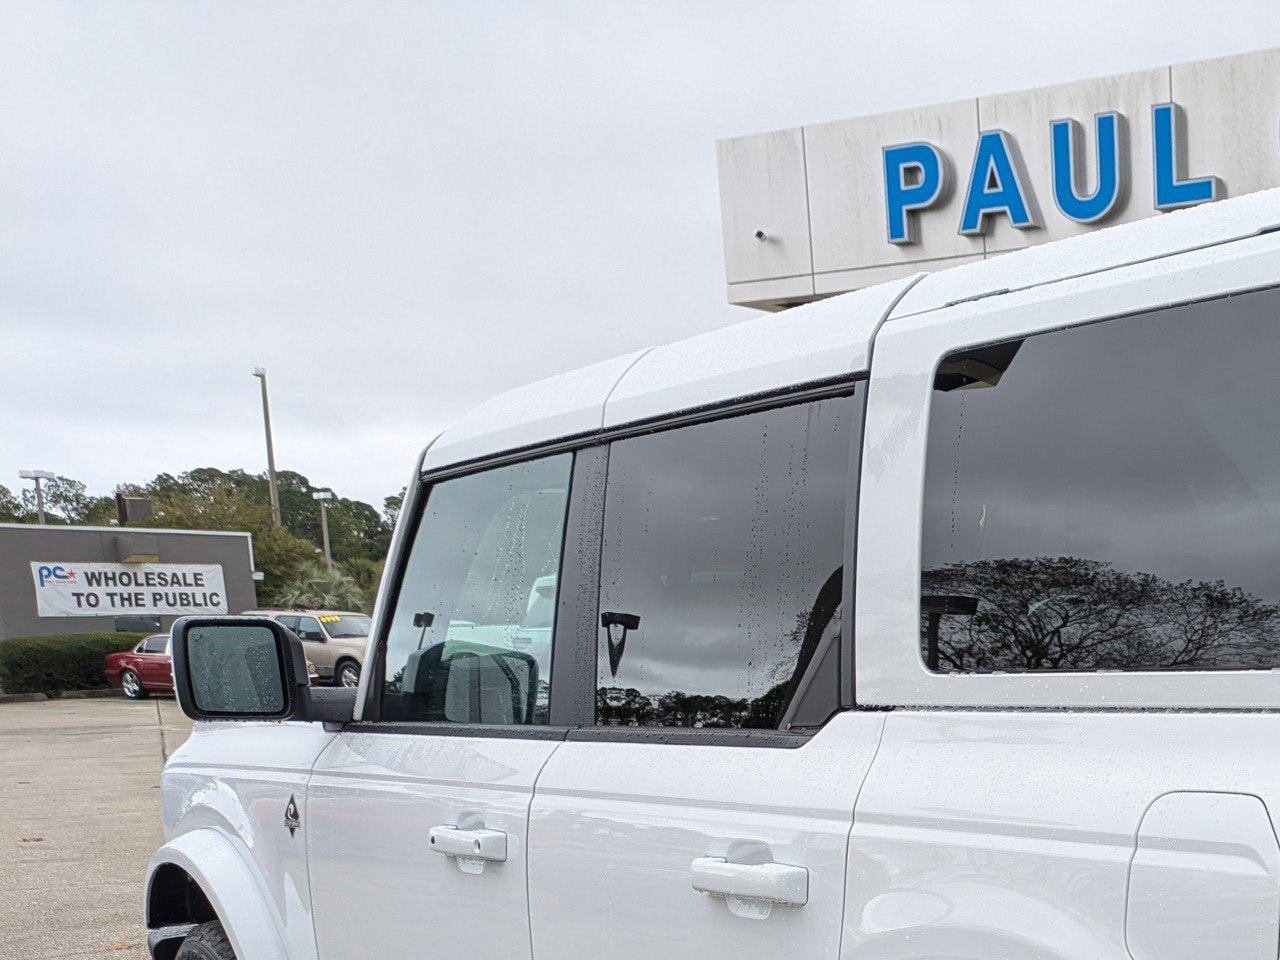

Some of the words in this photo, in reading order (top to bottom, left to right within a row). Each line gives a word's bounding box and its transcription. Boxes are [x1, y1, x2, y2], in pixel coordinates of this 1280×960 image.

[882, 102, 1215, 243] PAUL
[84, 571, 205, 587] WHOLESALE
[72, 592, 100, 608] TO
[105, 592, 146, 608] THE
[152, 592, 221, 608] PUBLIC
